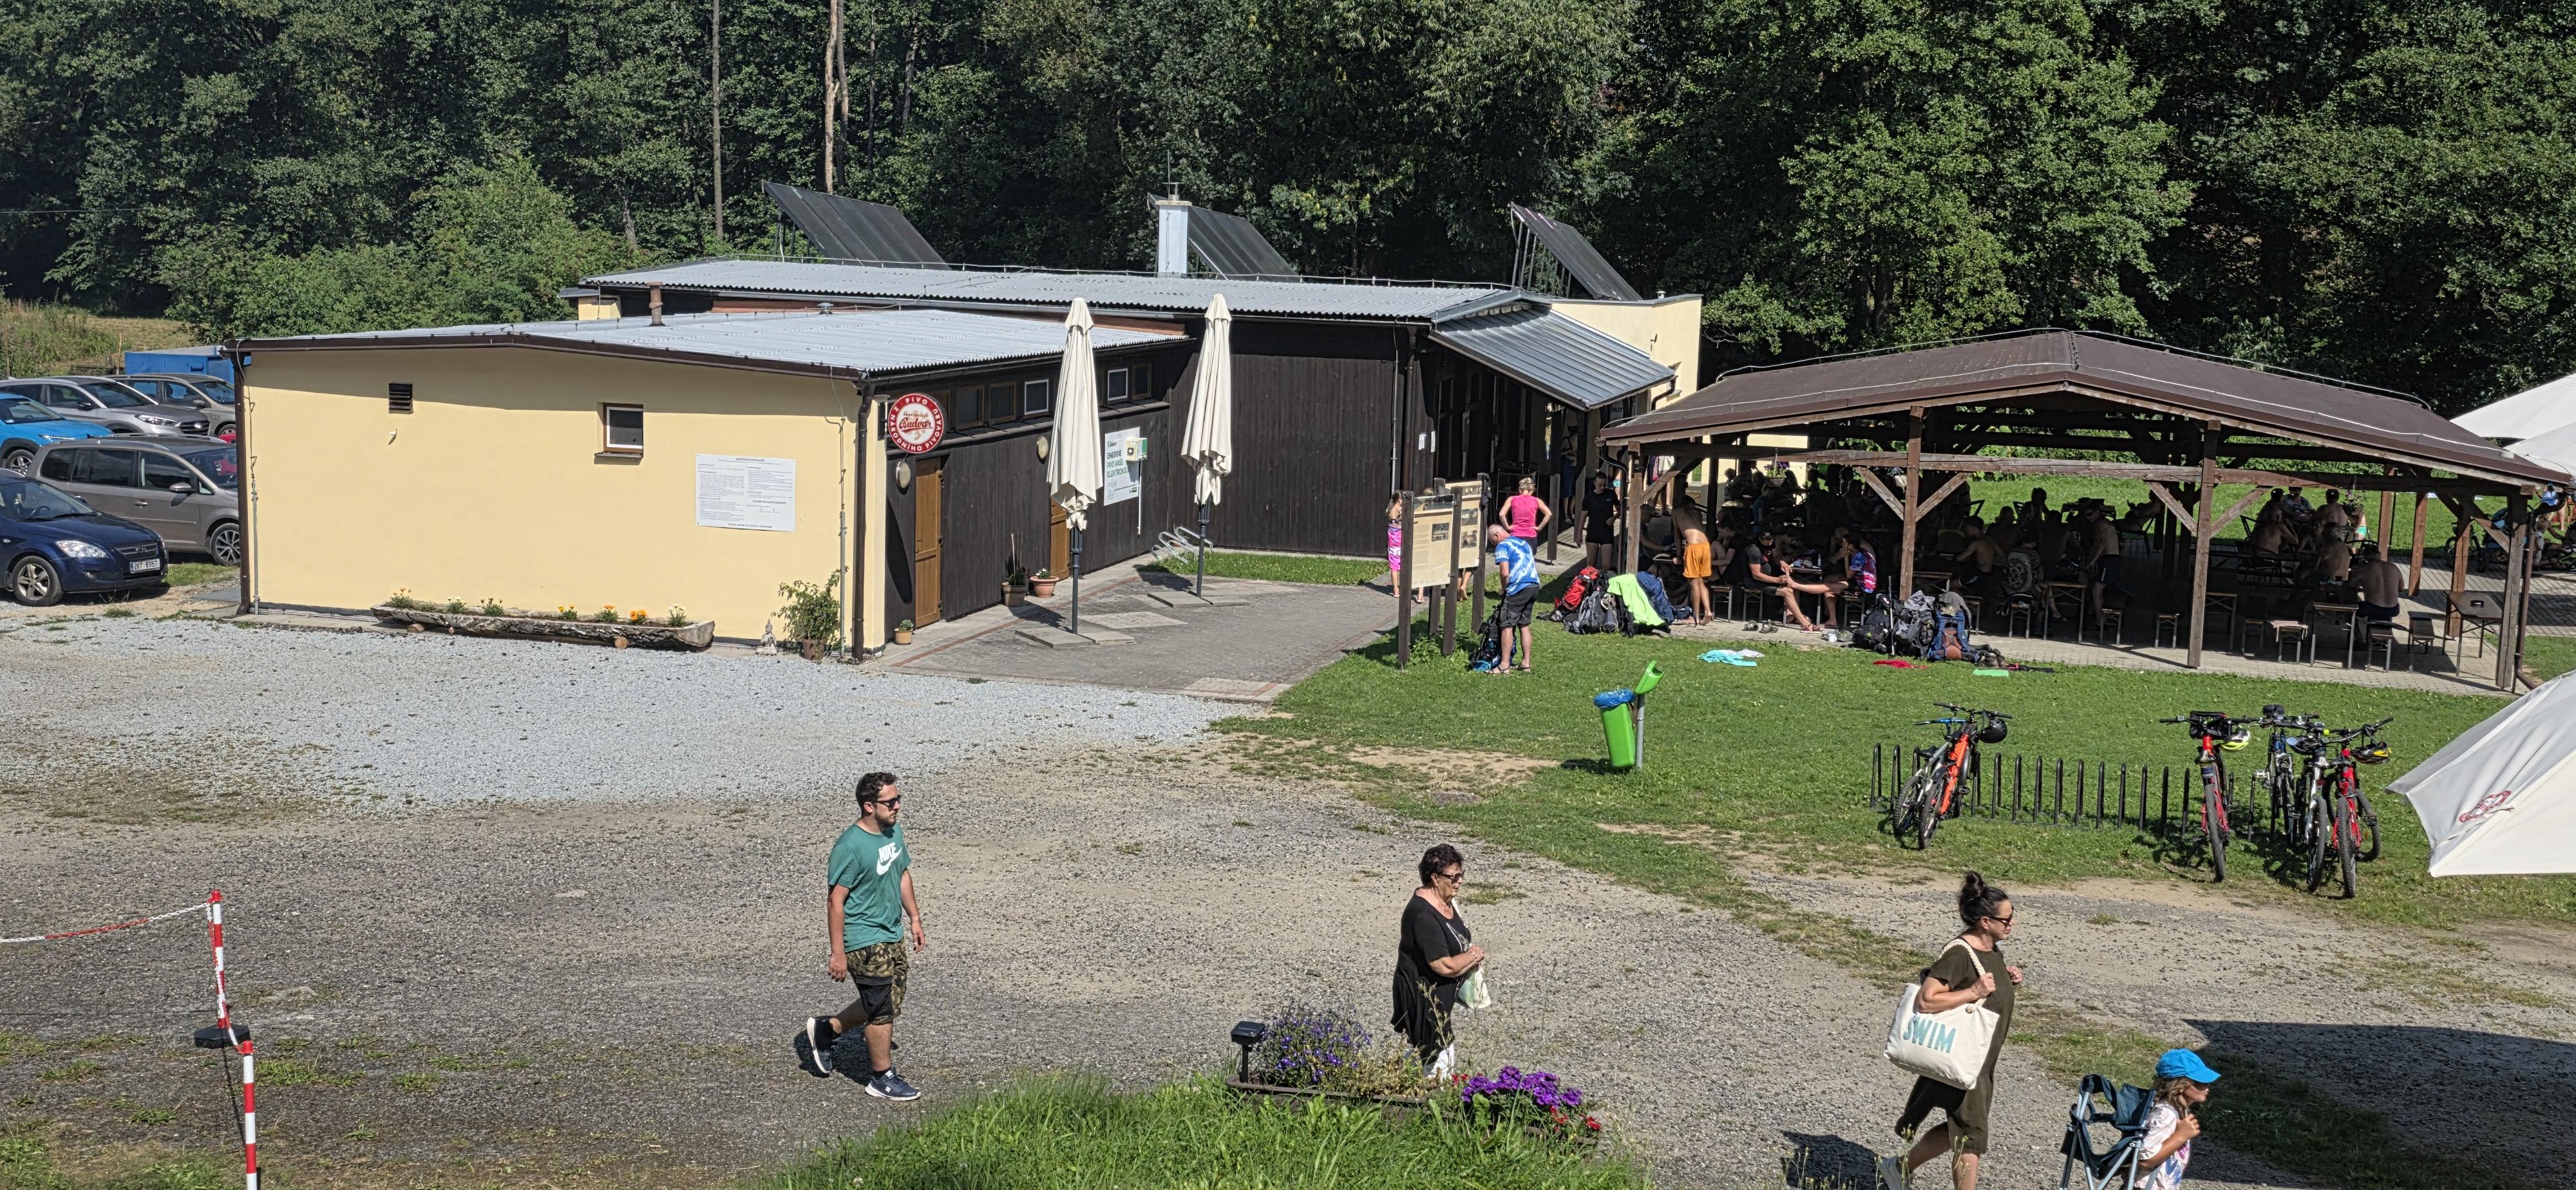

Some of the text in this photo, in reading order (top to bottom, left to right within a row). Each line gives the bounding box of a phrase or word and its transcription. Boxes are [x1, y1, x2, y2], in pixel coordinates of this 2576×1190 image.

[898, 417, 932, 430] Budvar
[925, 408, 942, 449] PIVOVARU
[878, 842, 896, 863] NIKE
[1903, 1015, 1956, 1053] SWIM
